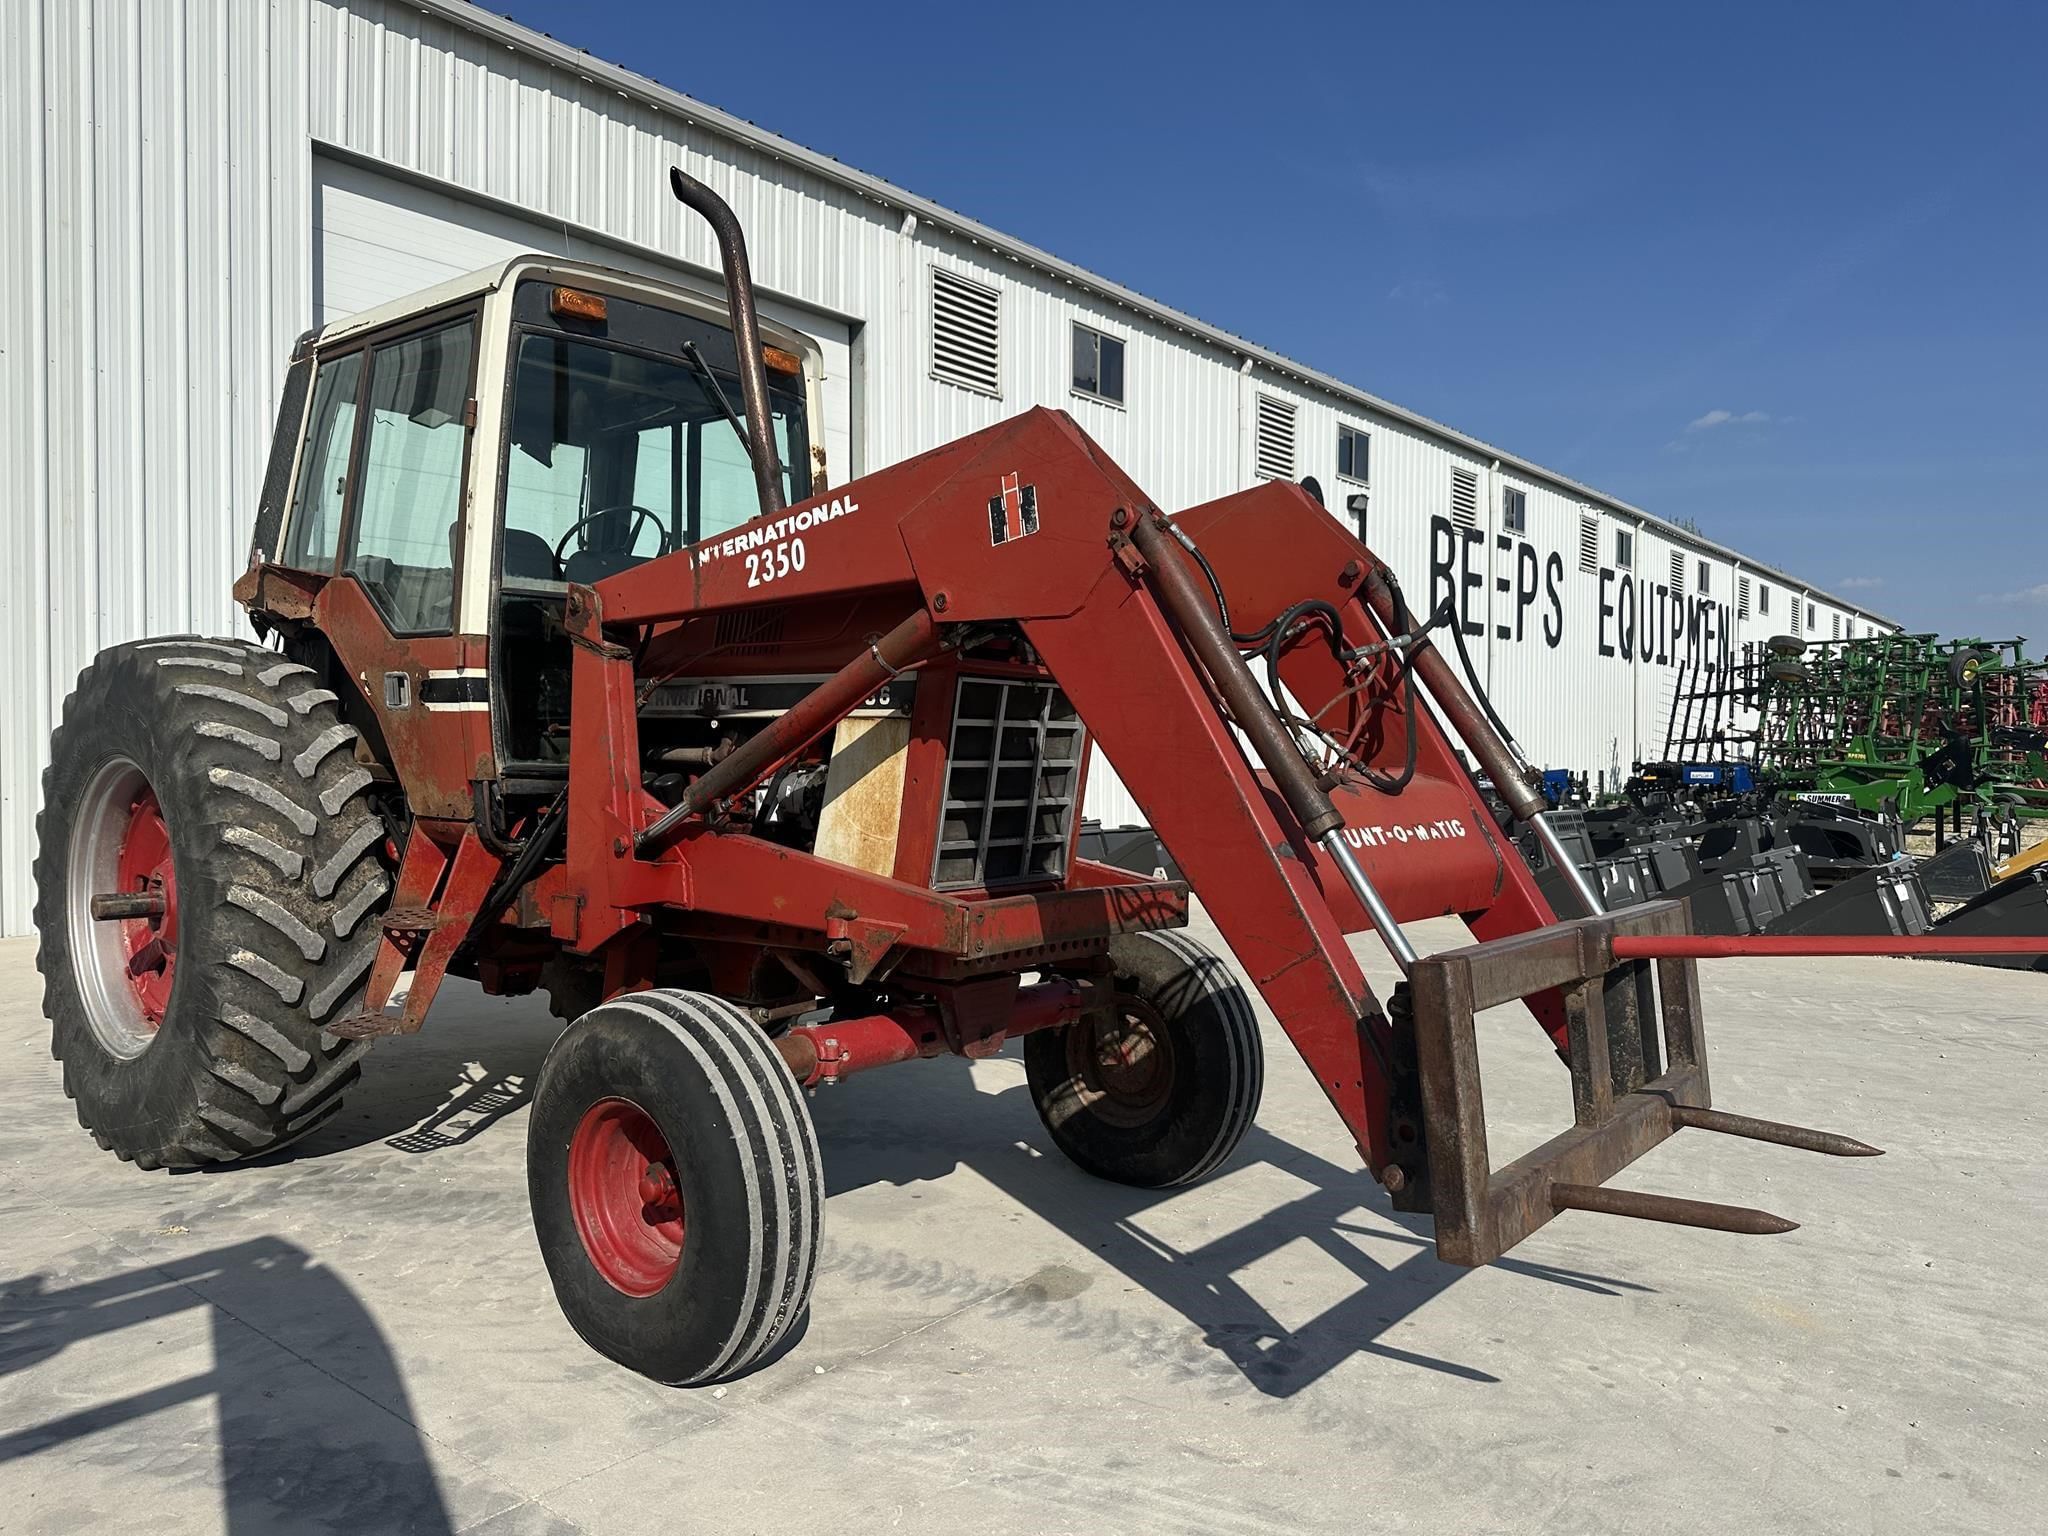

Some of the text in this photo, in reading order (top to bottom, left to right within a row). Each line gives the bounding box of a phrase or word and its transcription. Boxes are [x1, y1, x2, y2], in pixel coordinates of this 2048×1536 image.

[745, 538, 806, 588] 2350
[1599, 567, 1743, 673] EQUIPMEN
[1317, 819, 1466, 852] UNT-O-MATIC
